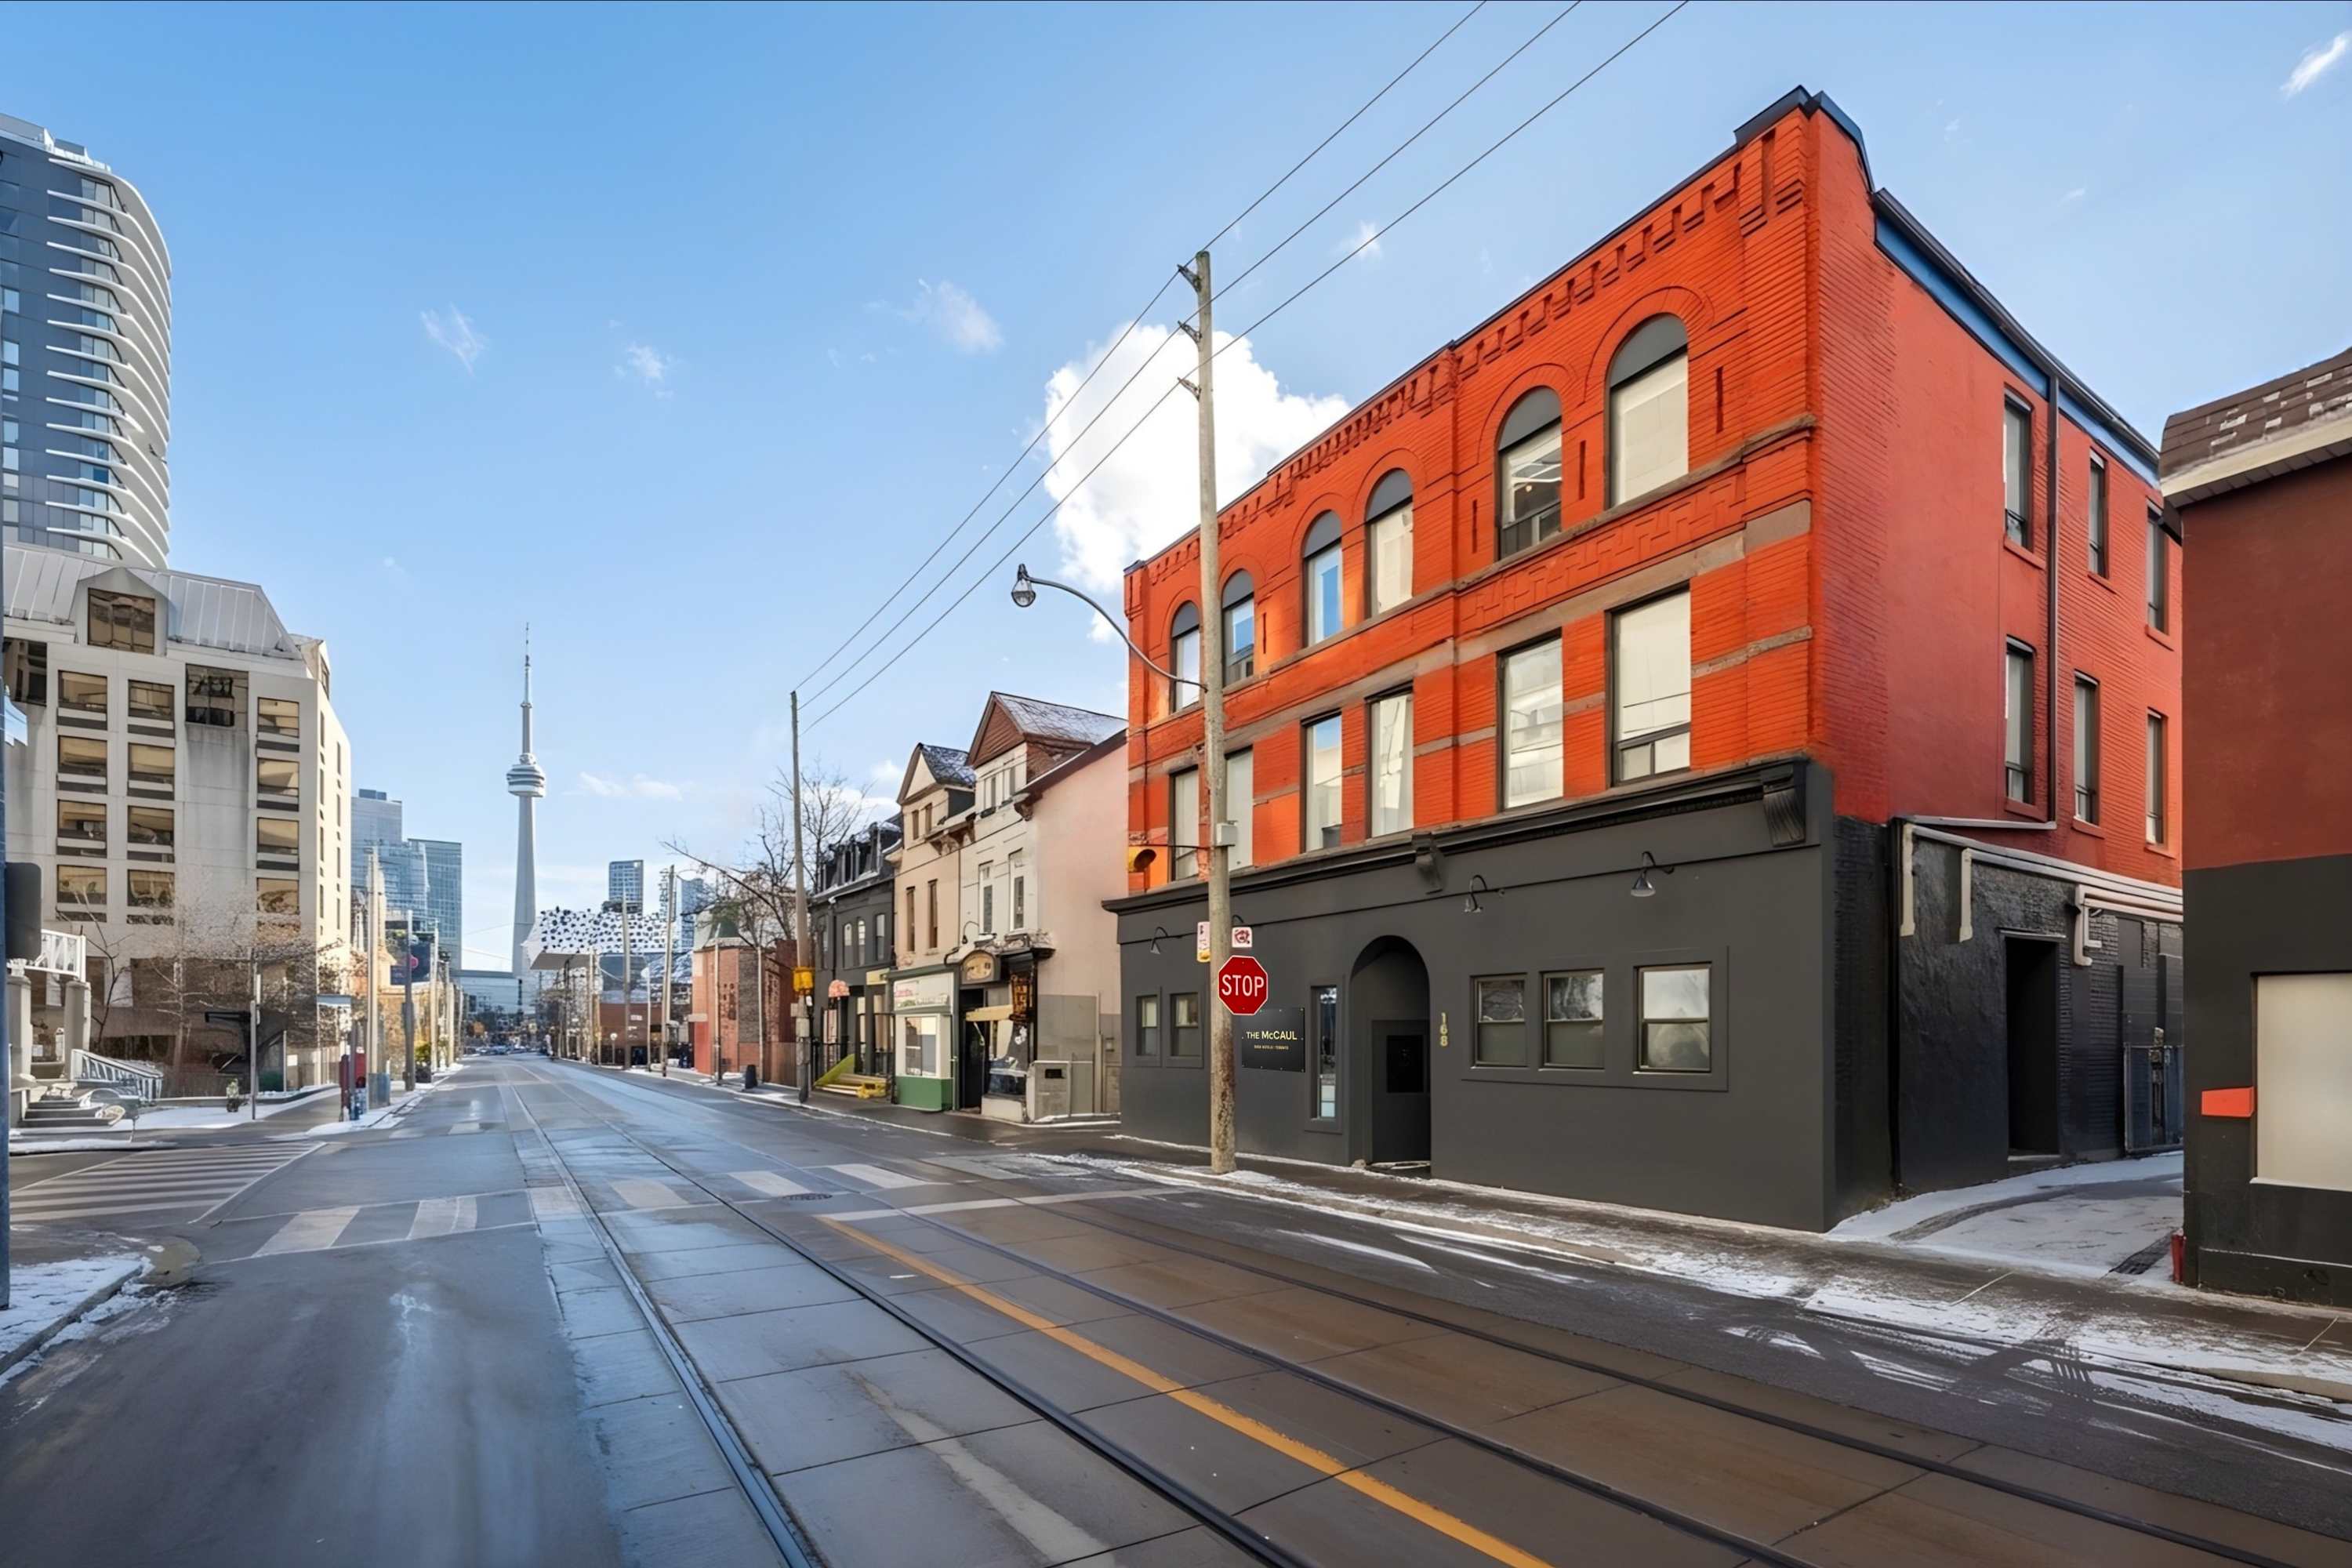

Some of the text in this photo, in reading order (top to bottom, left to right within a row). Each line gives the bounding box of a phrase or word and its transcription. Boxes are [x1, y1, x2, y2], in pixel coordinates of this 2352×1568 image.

[1221, 974, 1265, 996] STOP
[1247, 1030, 1298, 1040] THE McCAUL
